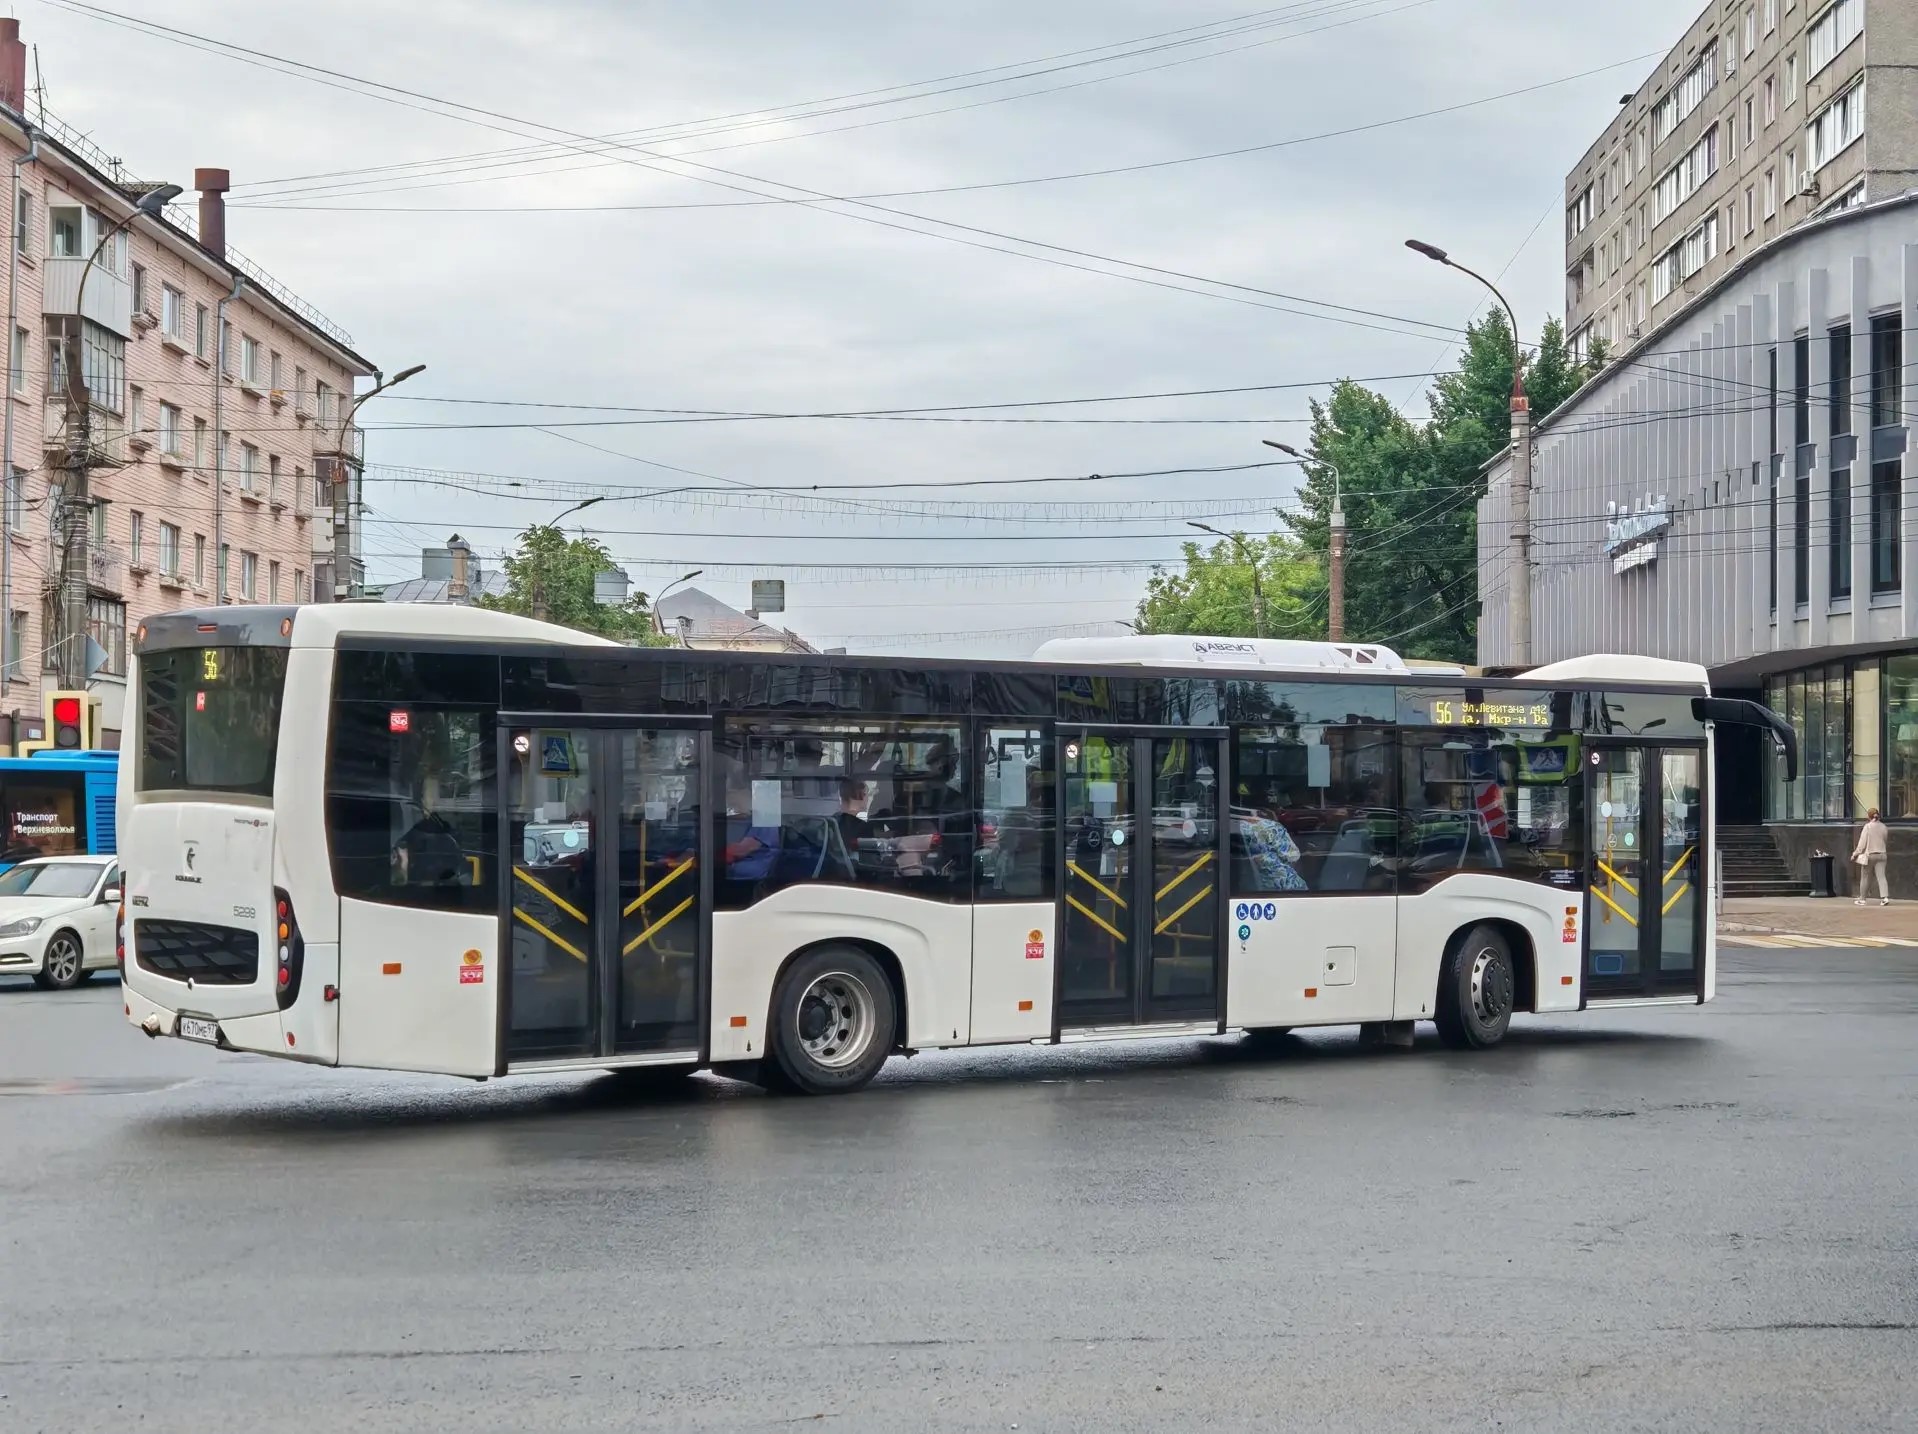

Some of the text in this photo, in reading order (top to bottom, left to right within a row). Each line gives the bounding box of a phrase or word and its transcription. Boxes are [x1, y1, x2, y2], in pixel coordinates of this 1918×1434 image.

[204, 650, 217, 680] 56
[1436, 701, 1452, 724] 56
[1533, 712, 1549, 726] Ра
[17, 812, 59, 823] Транспорт
[17, 825, 76, 836] Верхневолжья
[233, 905, 256, 919] 5299
